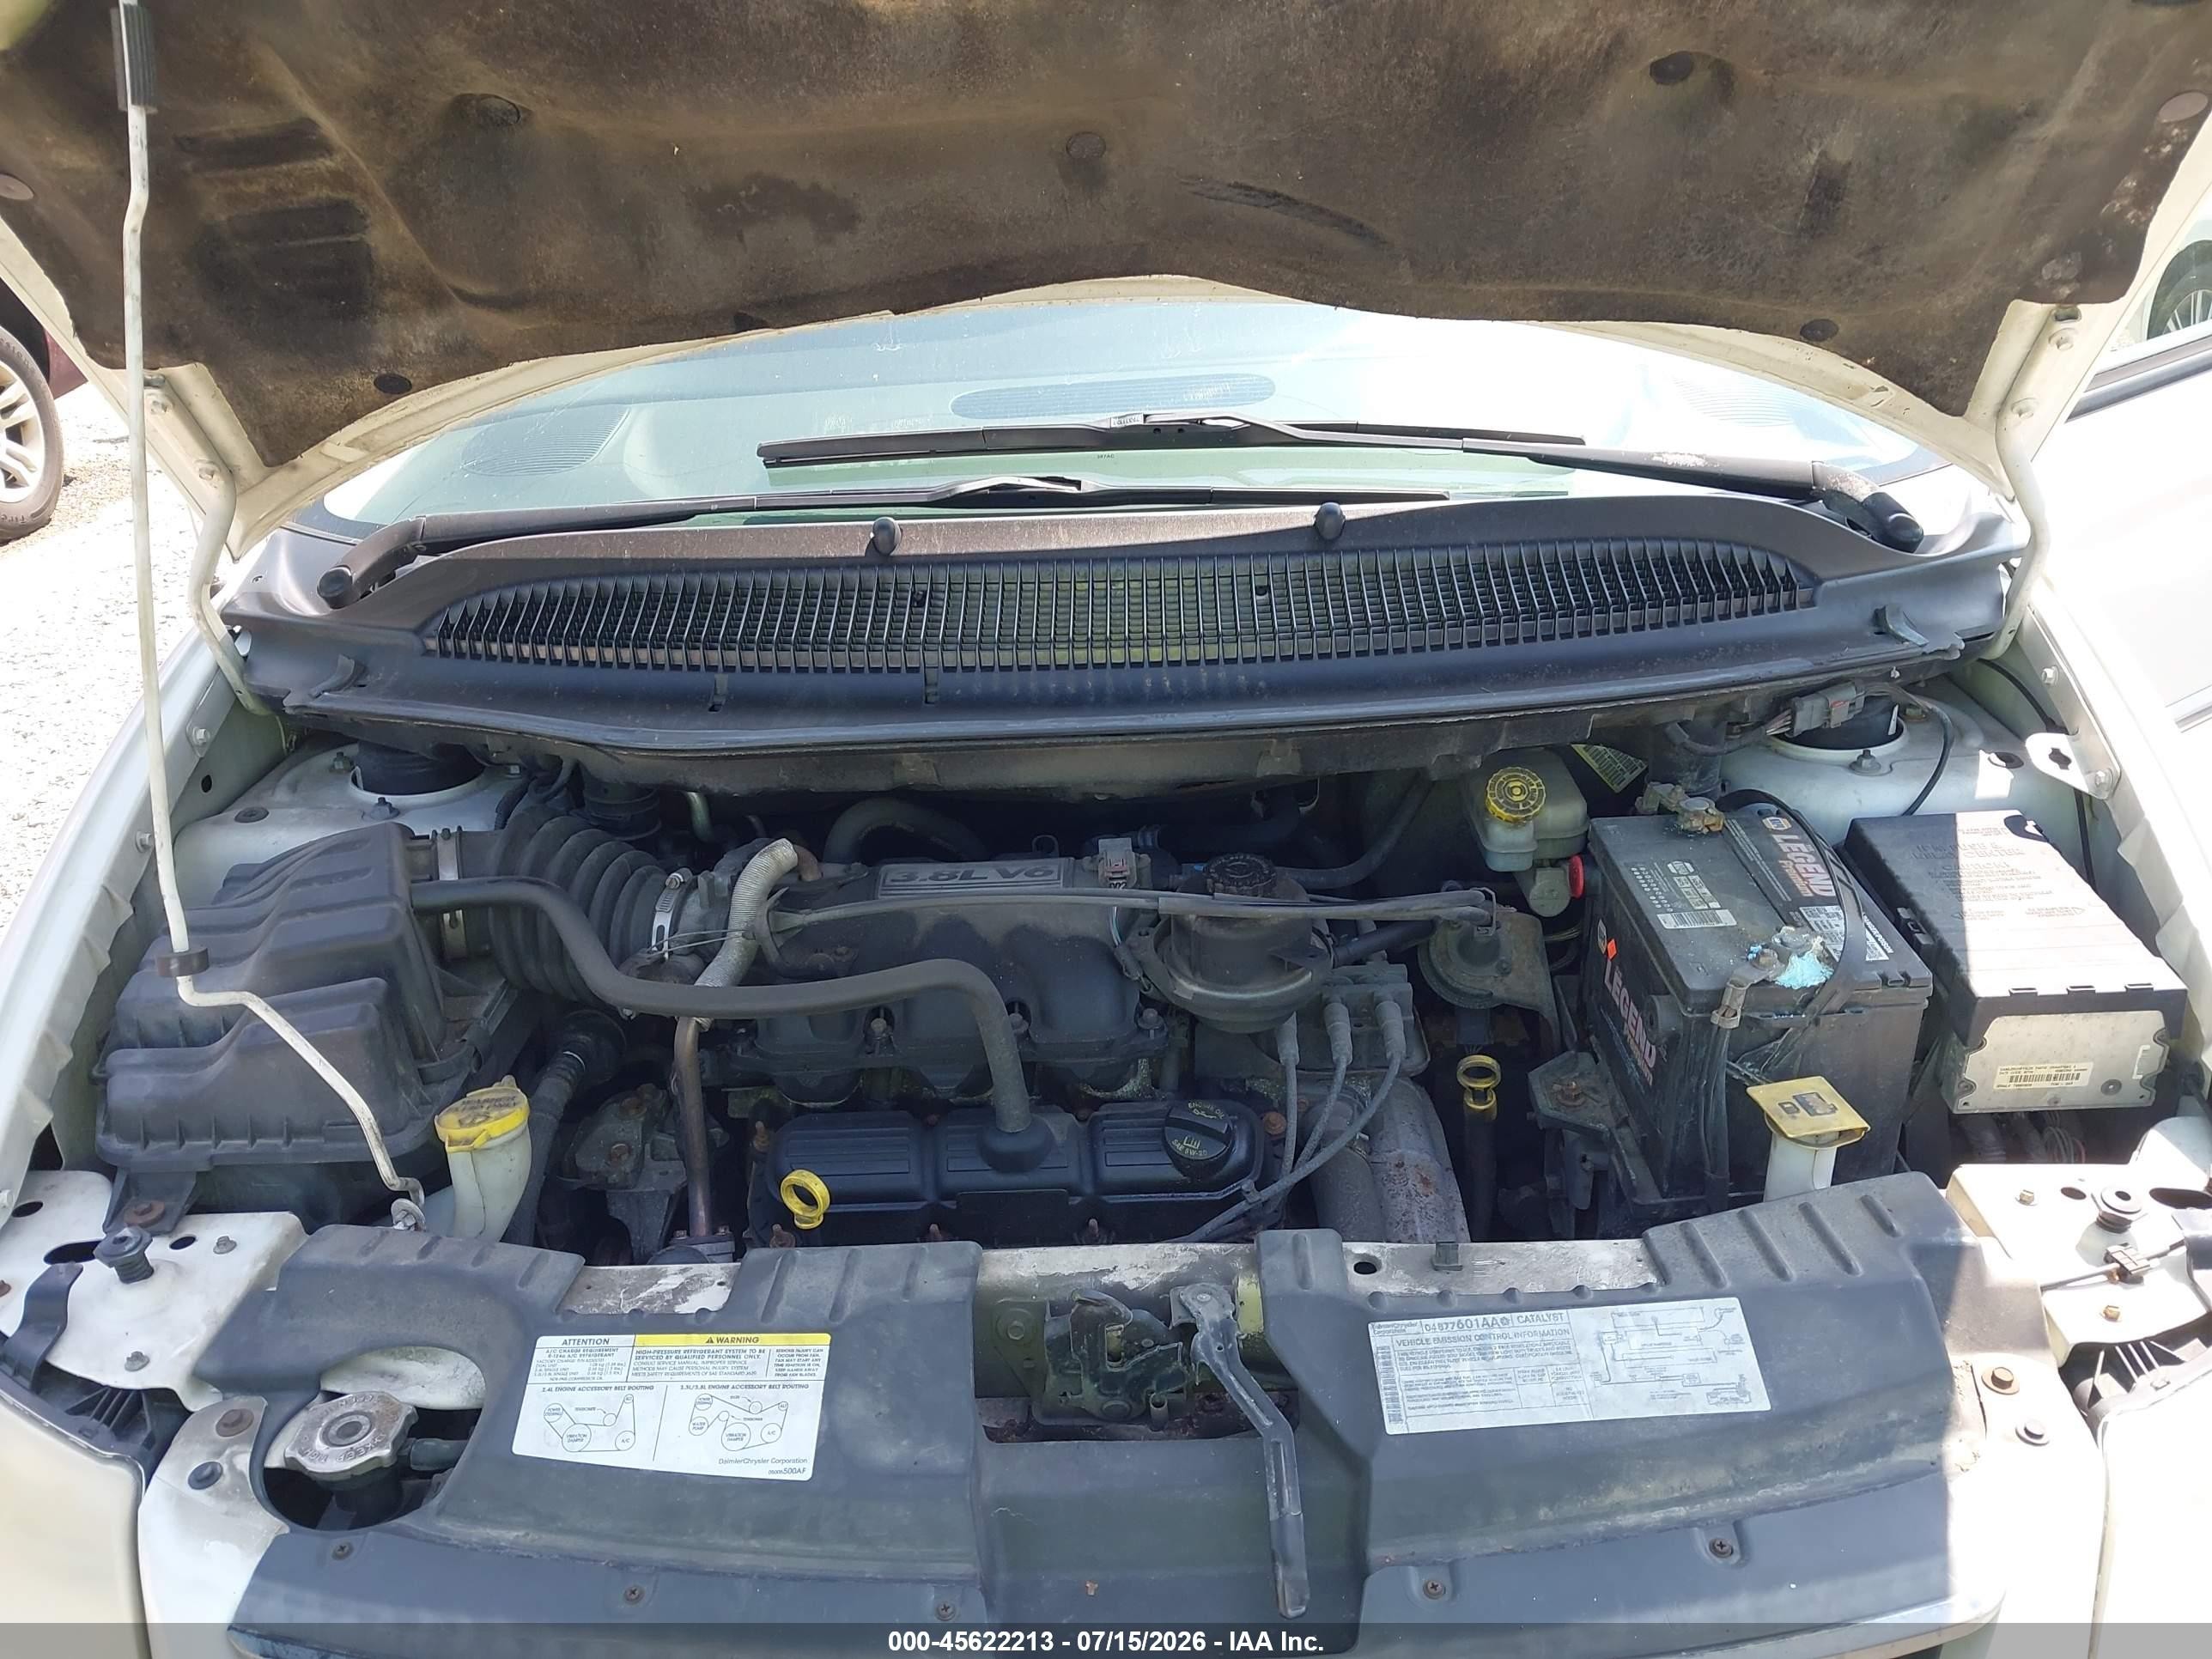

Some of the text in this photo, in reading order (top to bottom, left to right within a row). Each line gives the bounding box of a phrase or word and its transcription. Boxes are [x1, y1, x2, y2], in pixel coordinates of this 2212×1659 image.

[890, 866, 1054, 882] 3.8L V6
[1516, 1313, 1564, 1324] CATALYST
[1395, 1328, 1570, 1347] VEHICLE EMISSION CONTROL INFORMATION
